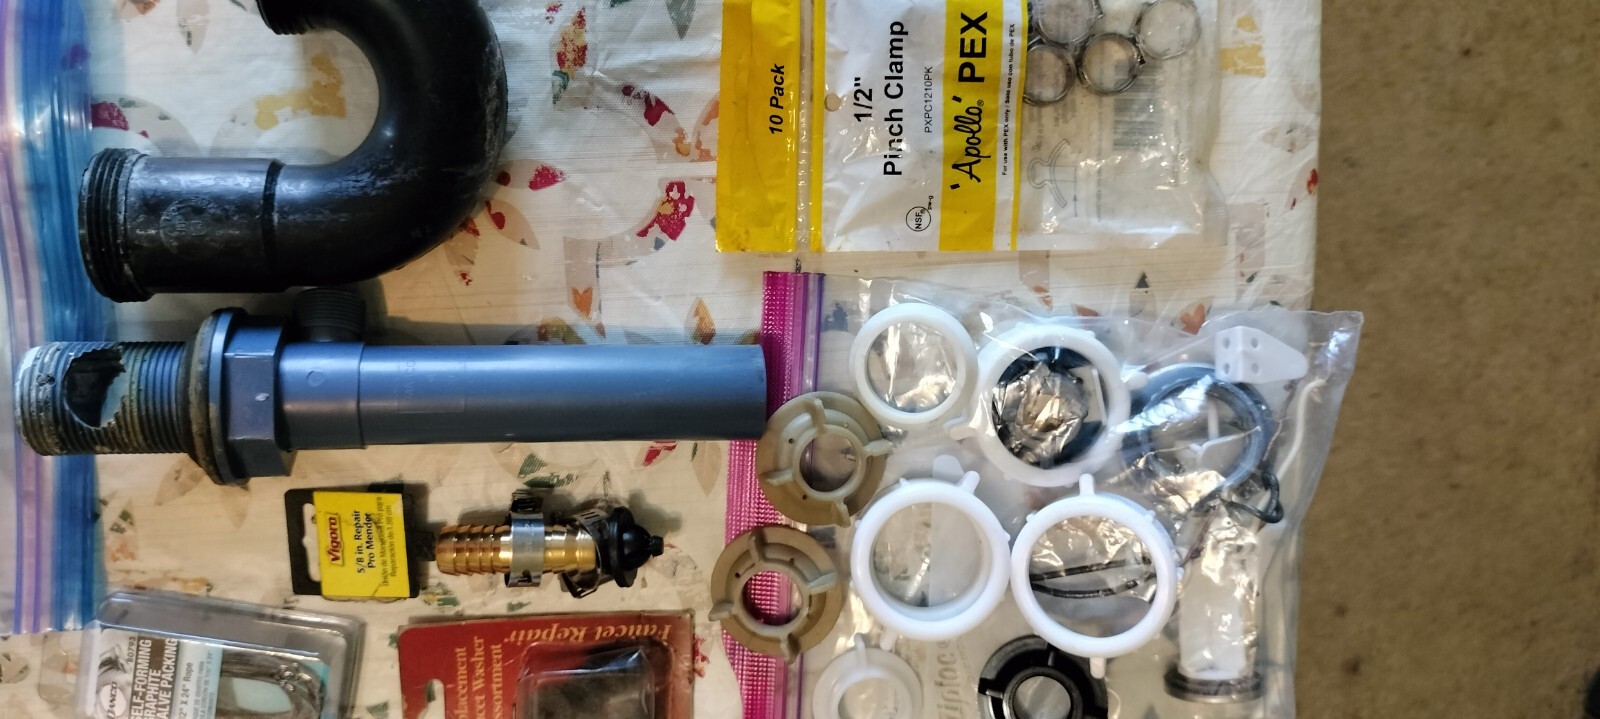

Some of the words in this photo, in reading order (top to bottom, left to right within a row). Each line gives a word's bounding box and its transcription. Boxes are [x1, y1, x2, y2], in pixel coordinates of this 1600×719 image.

[957, 11, 988, 83] PEX
[1008, 39, 1014, 47] de
[884, 21, 909, 99] Clamp
[770, 64, 785, 109] Pack
[853, 76, 873, 122] 1/2"
[924, 66, 933, 133] PXPC1210PK
[769, 114, 783, 134] 10
[883, 108, 904, 176] Pinch
[376, 496, 385, 512] para
[386, 504, 392, 516] cm
[352, 510, 364, 540] Repair
[364, 512, 374, 550] Mender
[327, 516, 342, 562] Vigoro
[355, 542, 364, 554] in.
[356, 556, 366, 574] 5/8
[368, 553, 376, 568] Pro
[380, 559, 388, 568] de
[504, 622, 589, 645] Repair
[596, 624, 672, 640] Faucet
[127, 636, 136, 662] 80793
[160, 638, 178, 688] PACKING
[182, 662, 194, 682] Rope
[470, 636, 486, 691] Washer
[181, 684, 190, 698] 24"
